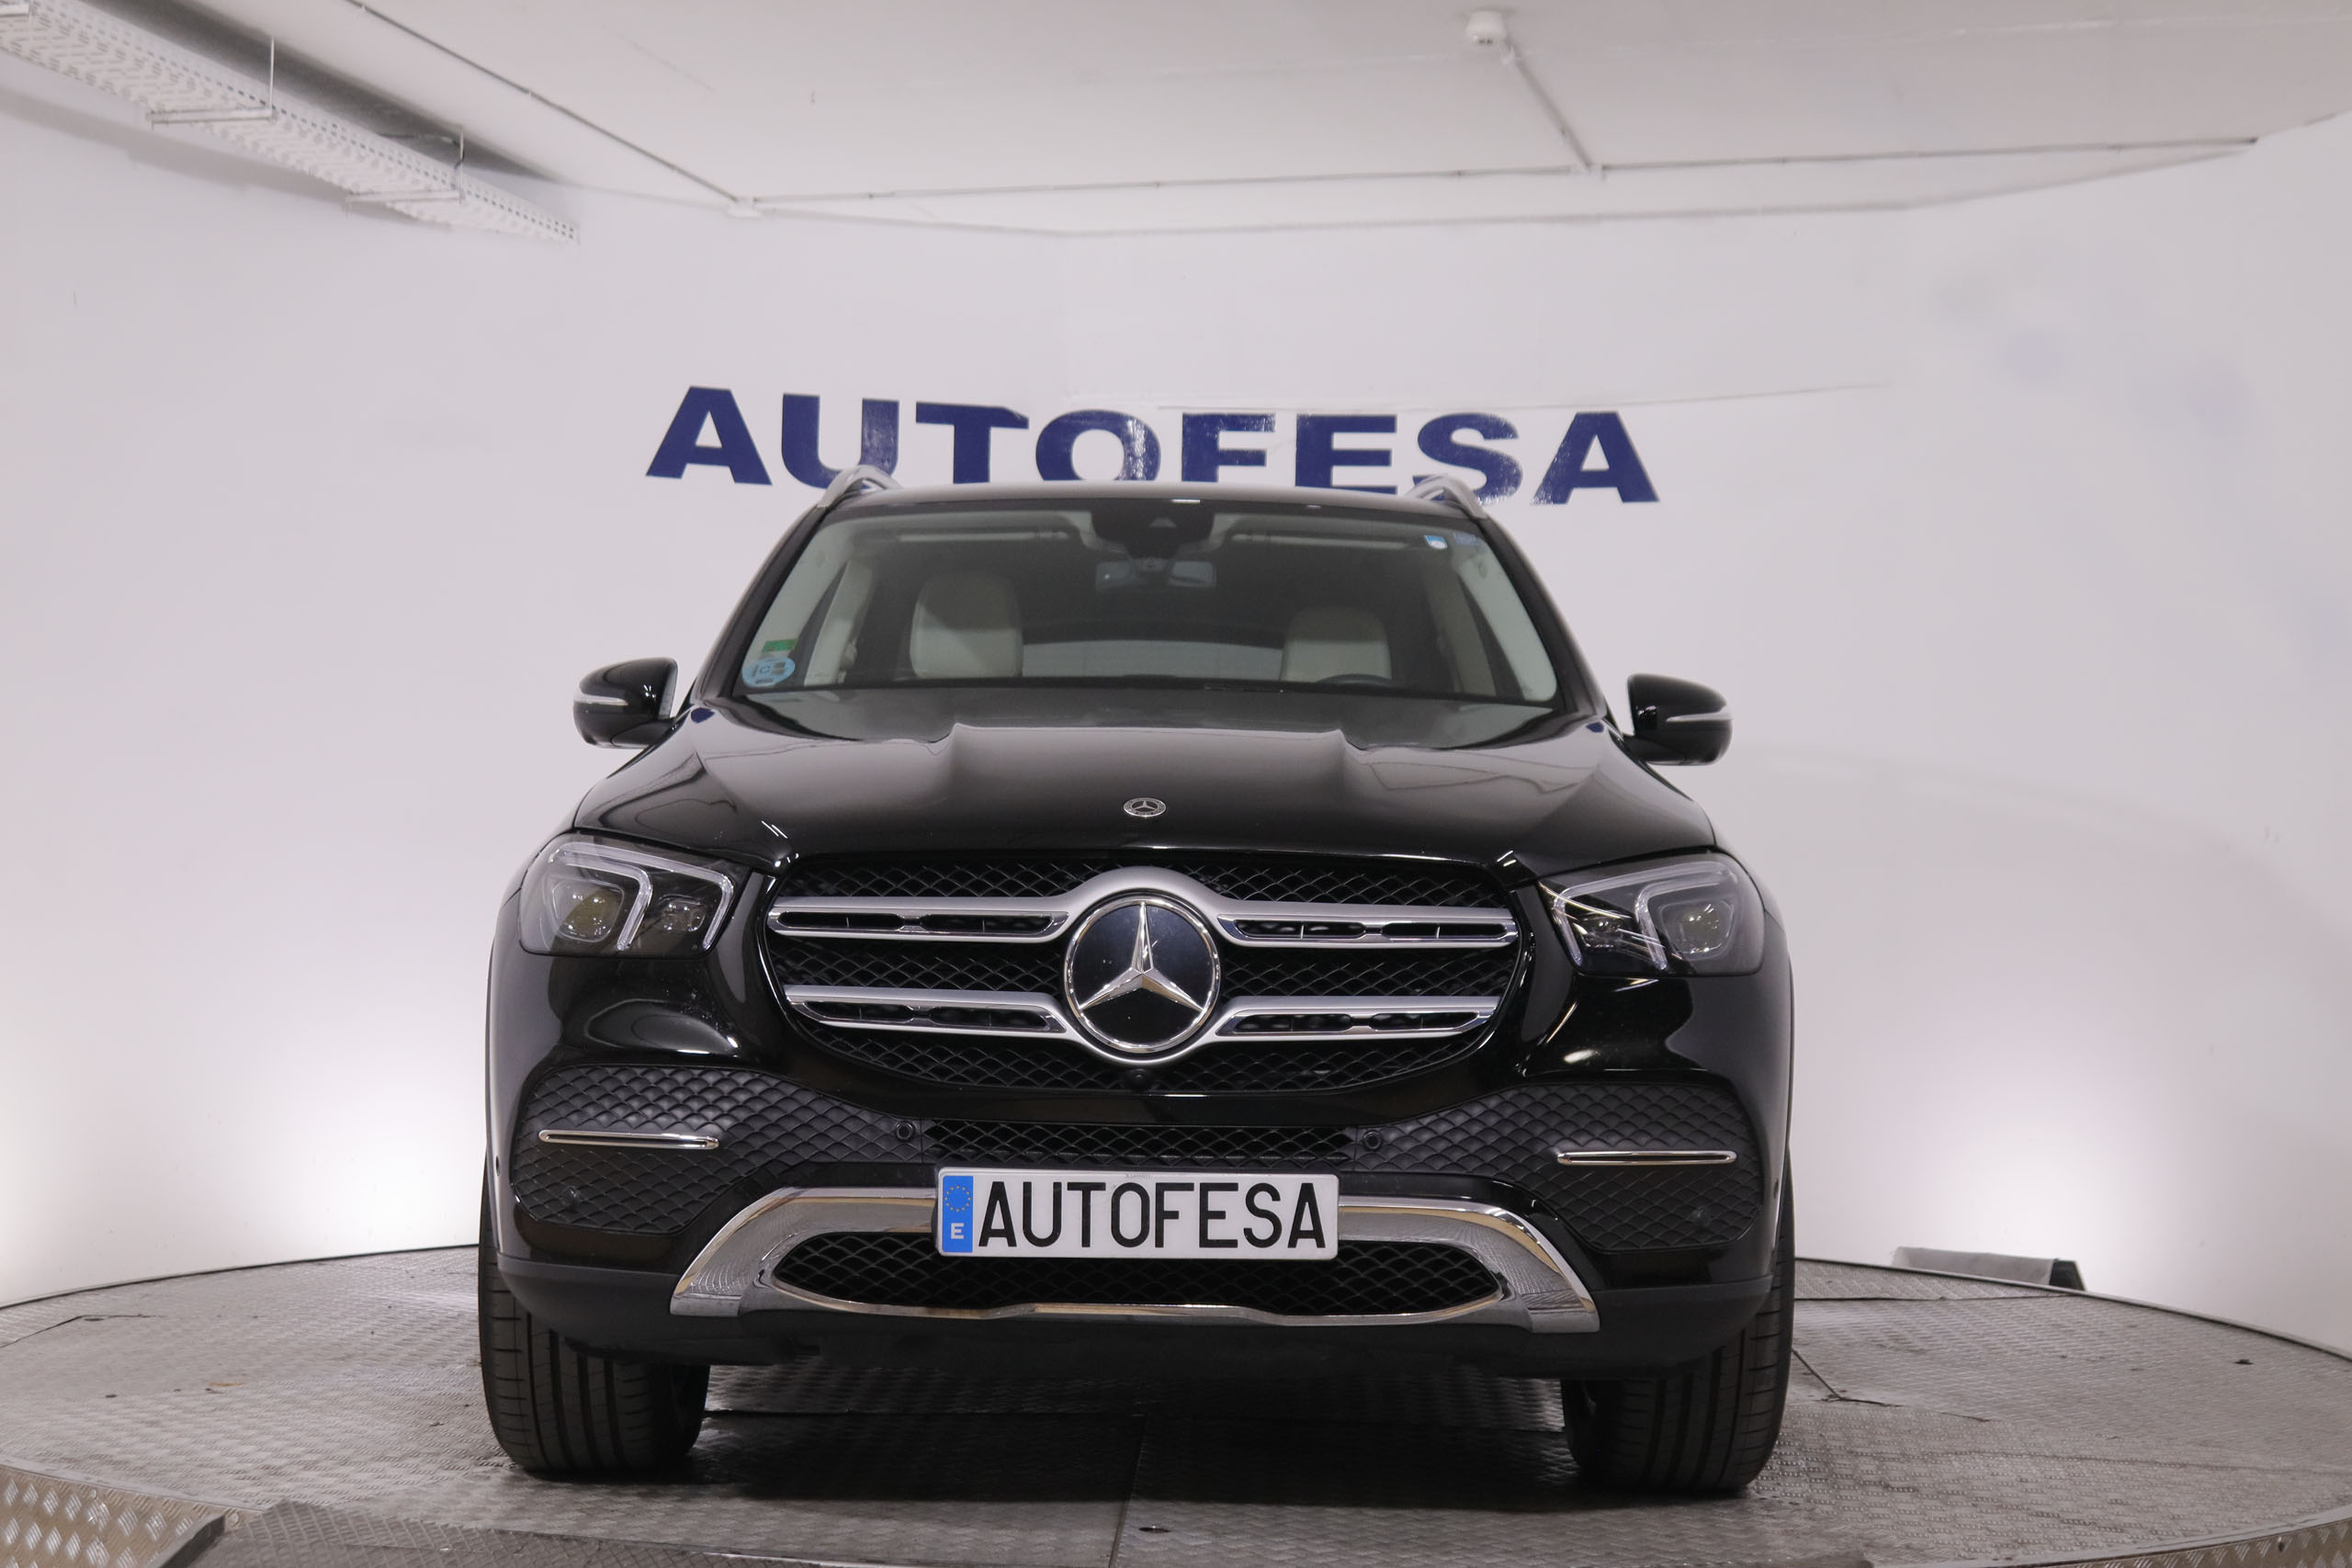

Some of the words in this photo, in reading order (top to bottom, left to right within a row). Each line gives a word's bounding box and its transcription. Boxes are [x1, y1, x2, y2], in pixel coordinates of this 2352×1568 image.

[646, 387, 1659, 505] AUTOFESA
[949, 1223, 965, 1240] E
[978, 1180, 1326, 1249] AUTOFESA
